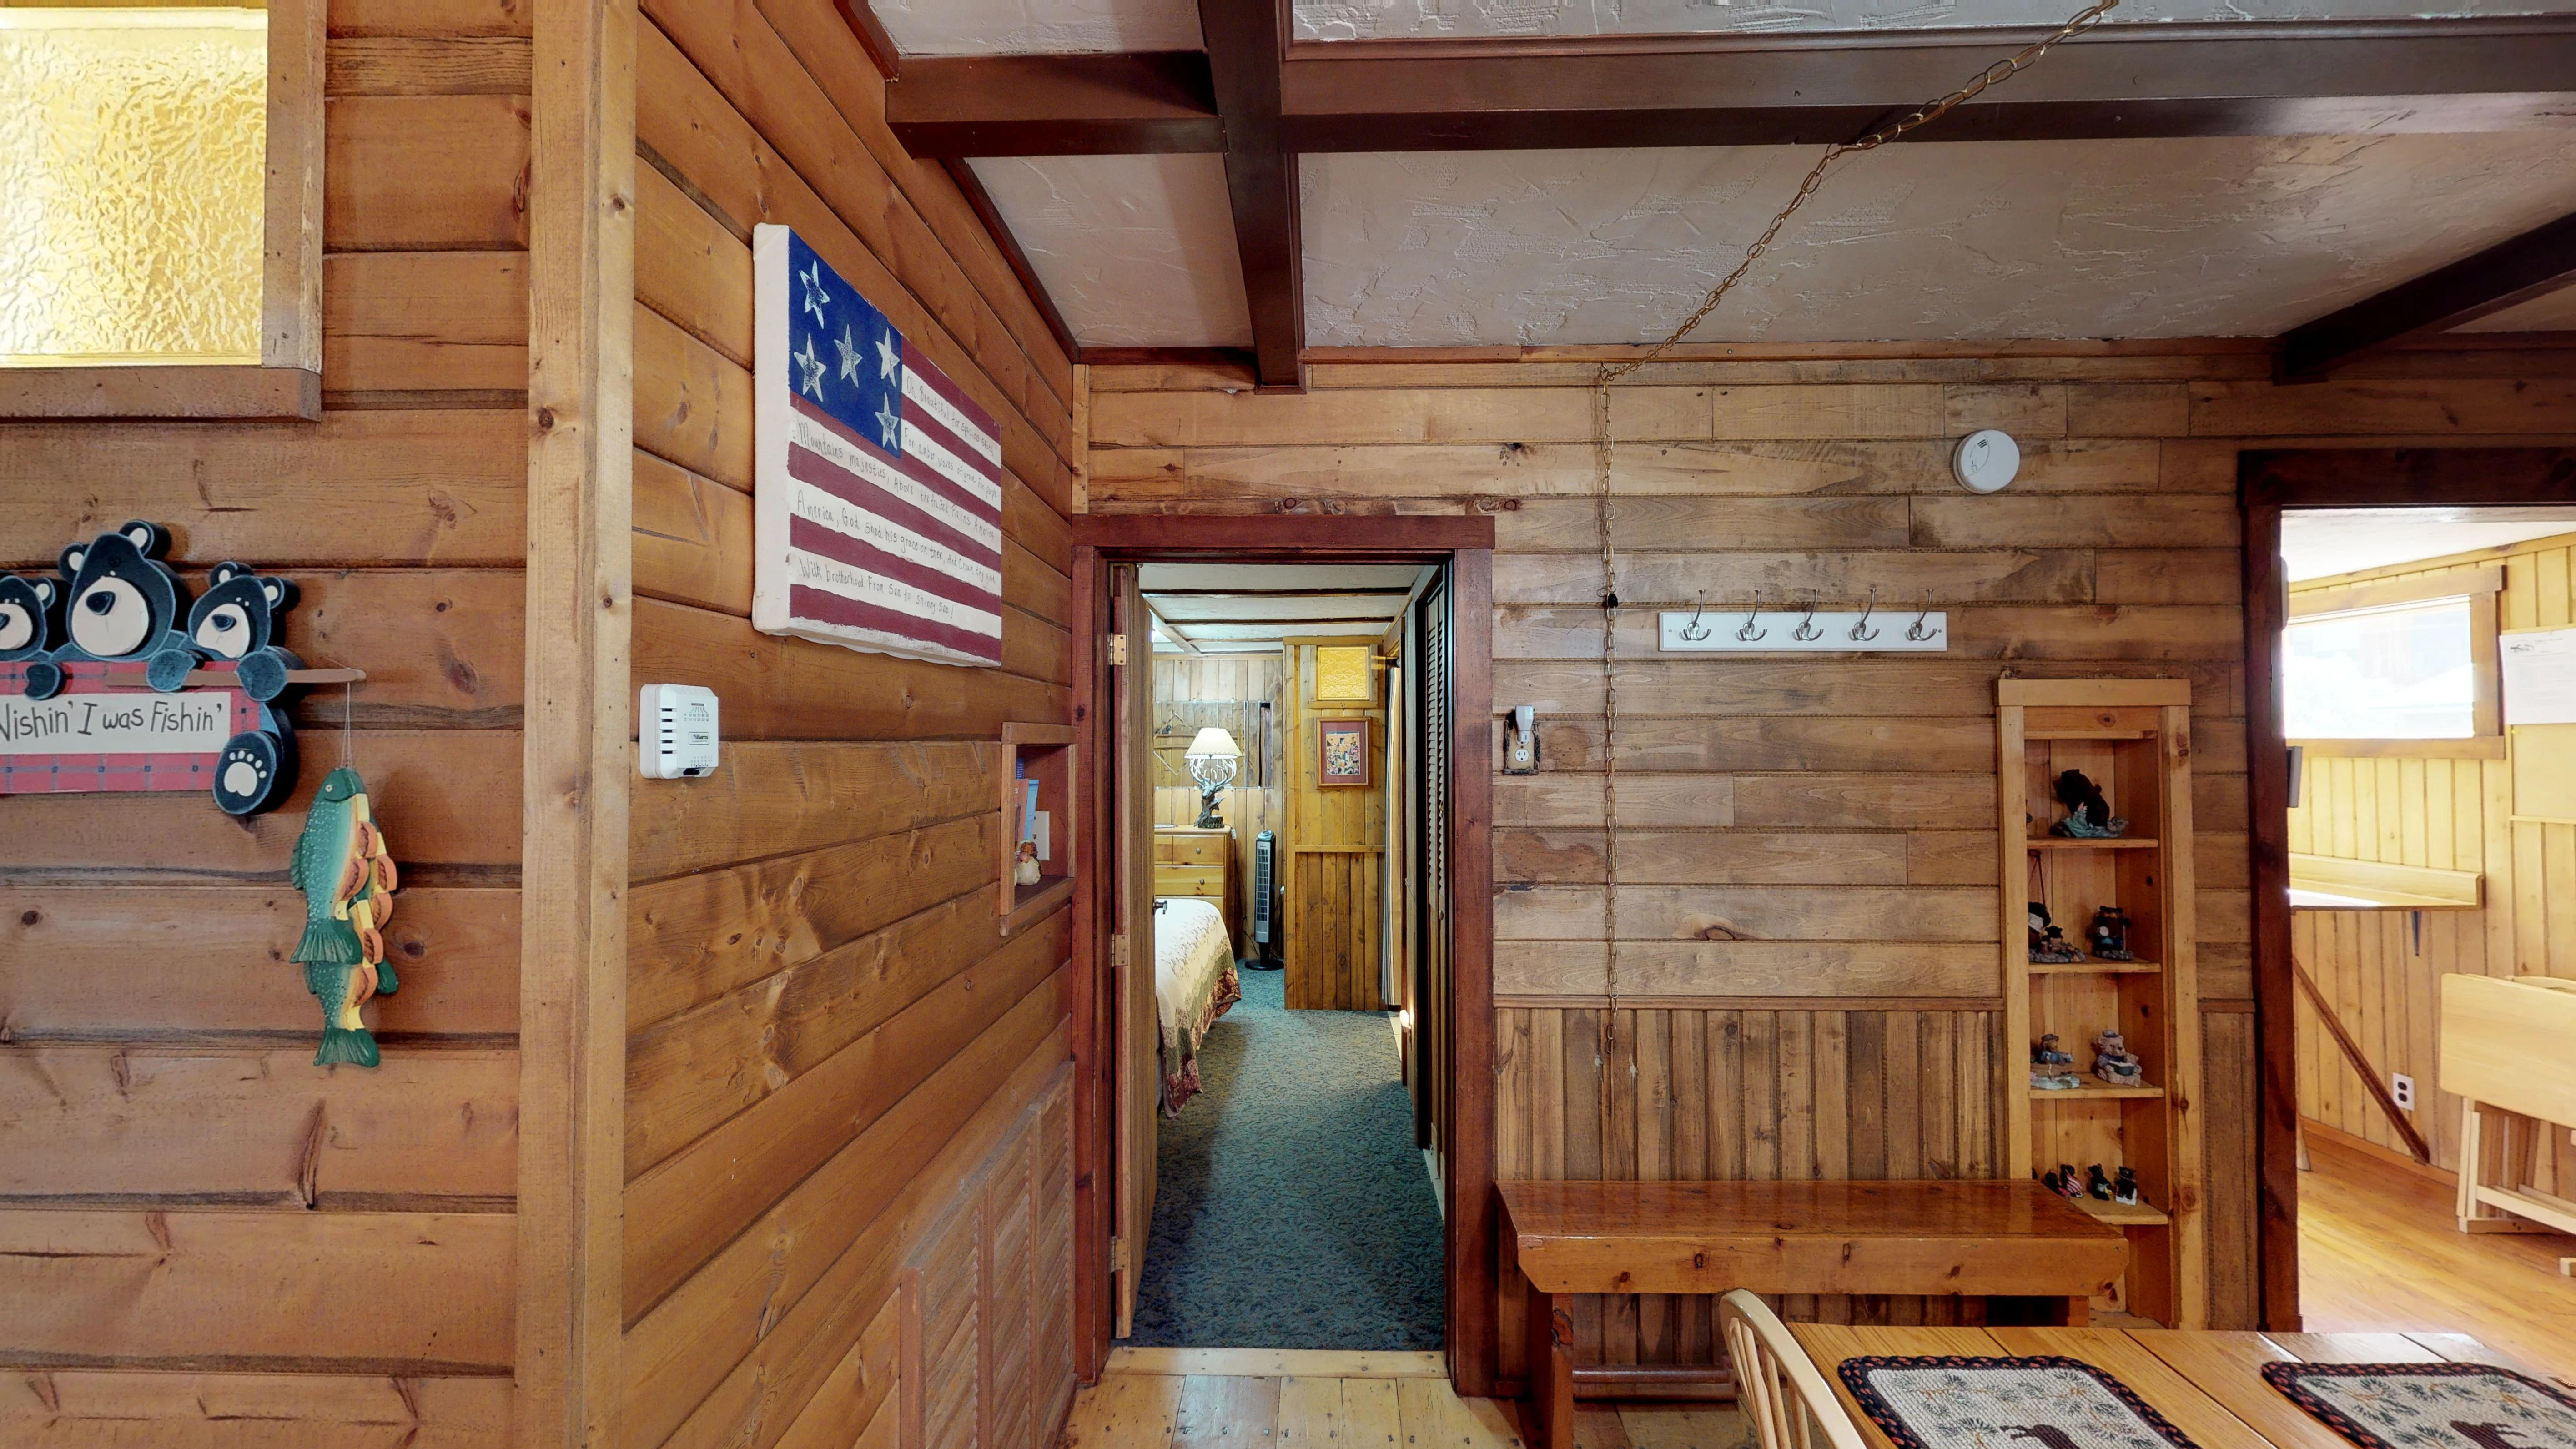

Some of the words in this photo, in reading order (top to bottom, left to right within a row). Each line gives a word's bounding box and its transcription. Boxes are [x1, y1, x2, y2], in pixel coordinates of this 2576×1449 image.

[907, 376, 916, 399] Oh
[904, 428, 914, 448] For
[798, 422, 843, 459] Mountains
[894, 477, 914, 495] Above
[842, 507, 860, 530] God
[885, 527, 897, 543] his
[900, 536, 918, 553] grace
[920, 544, 928, 555] on
[799, 557, 822, 579] With
[825, 564, 865, 588] brotherhood
[904, 589, 911, 602] to
[77, 702, 98, 736] I
[102, 708, 144, 730] was
[150, 701, 222, 733] Fishin'
